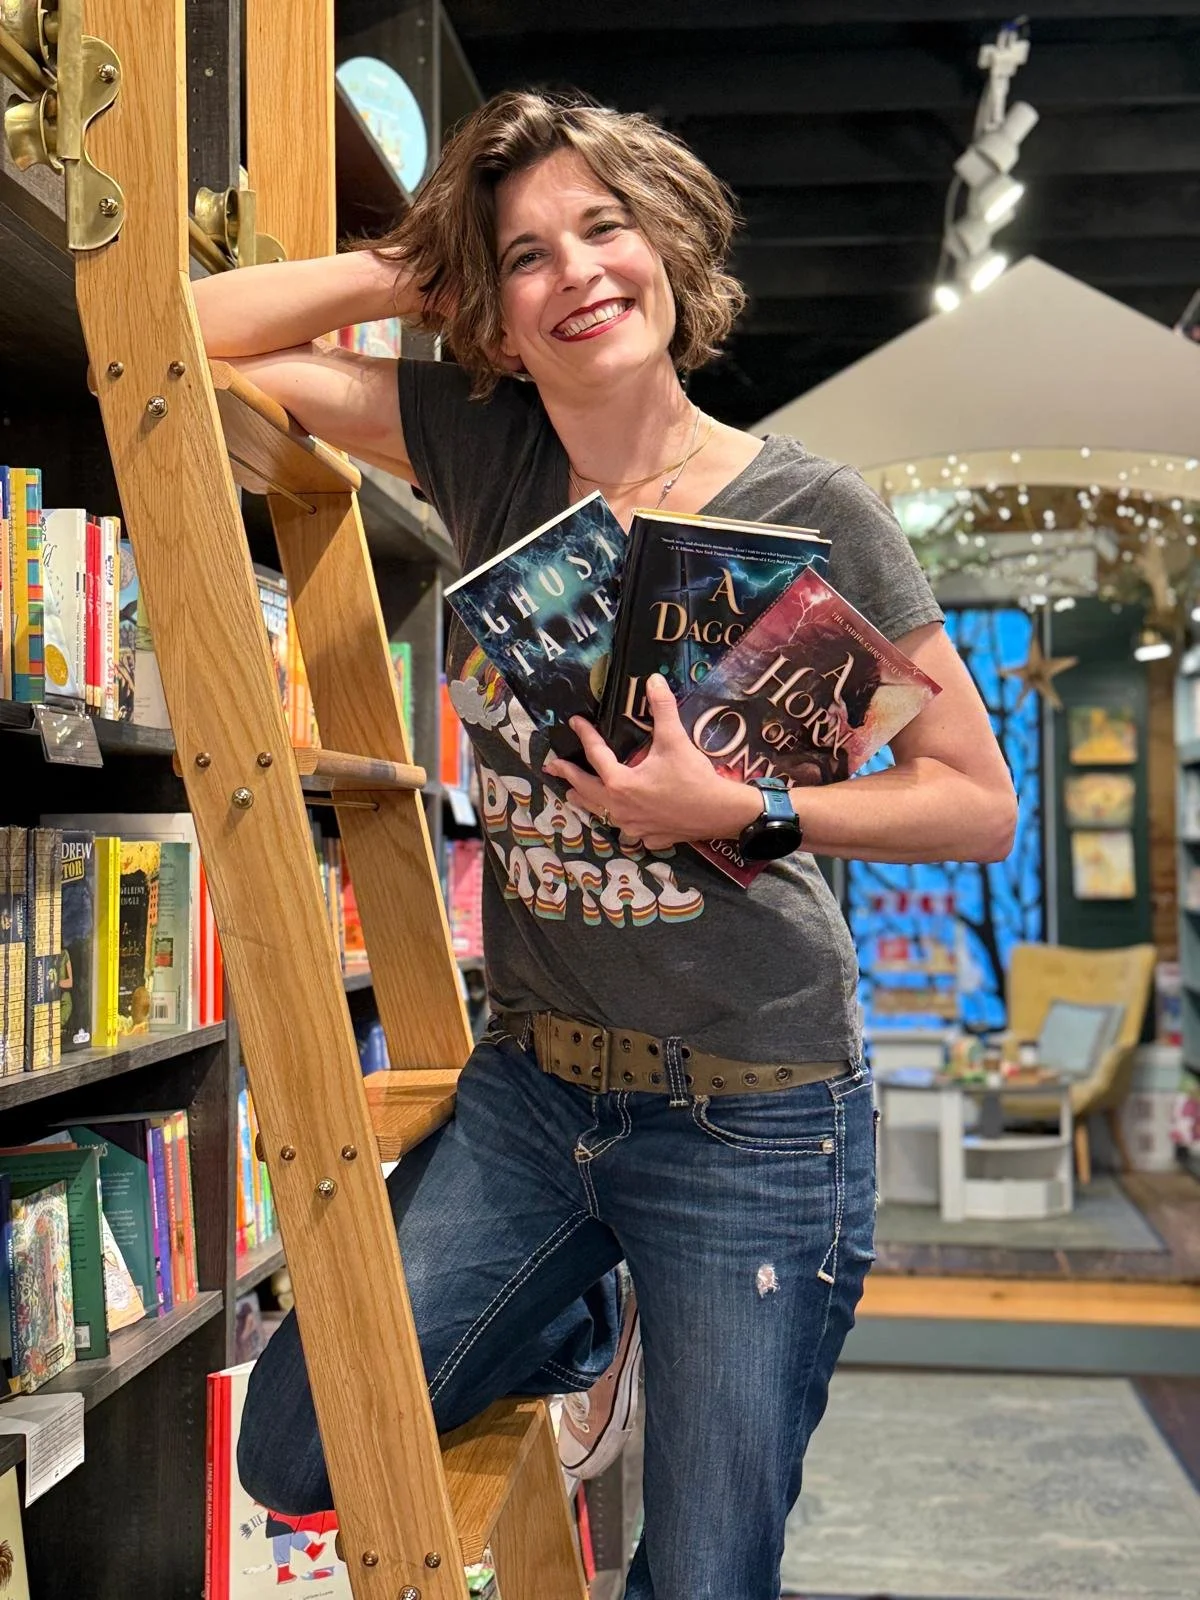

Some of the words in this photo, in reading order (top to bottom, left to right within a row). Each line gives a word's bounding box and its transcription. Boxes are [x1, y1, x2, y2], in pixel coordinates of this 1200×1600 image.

[481, 533, 618, 634] GHOST
[708, 567, 745, 615] A
[505, 585, 618, 676] TAME
[650, 601, 744, 649] DAGG
[830, 611, 846, 626] THE
[690, 660, 714, 682] O
[820, 652, 855, 705] A
[743, 654, 853, 760] HORN
[693, 705, 796, 788] ONY
[761, 722, 798, 752] OF
[61, 842, 92, 859] DREW
[62, 860, 83, 879] TOR
[707, 835, 749, 870] LYONS
